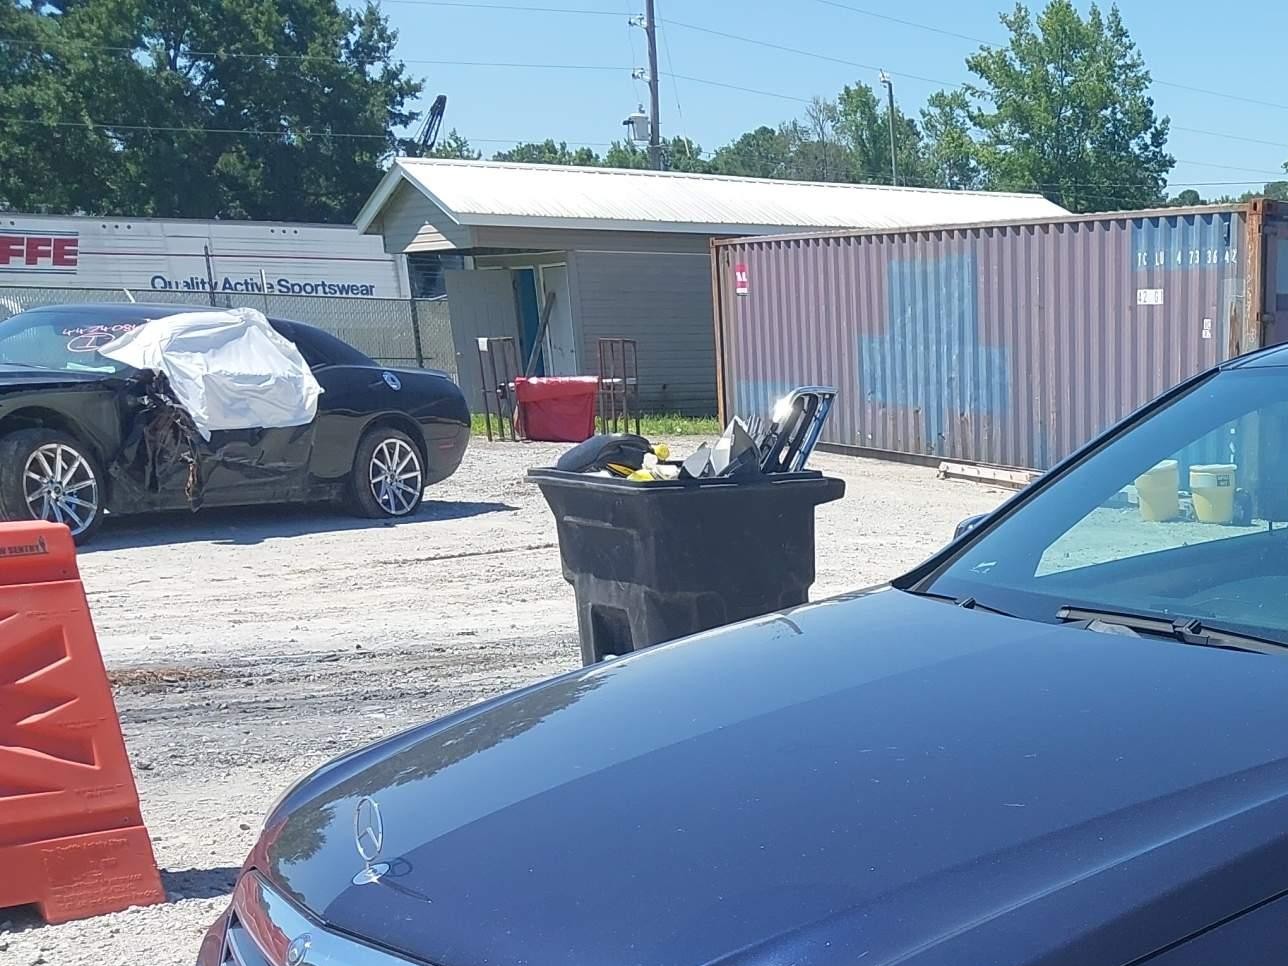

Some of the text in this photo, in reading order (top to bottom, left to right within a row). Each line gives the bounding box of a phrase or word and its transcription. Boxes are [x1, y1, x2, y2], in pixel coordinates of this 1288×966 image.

[151, 275, 375, 297] Quality Active Sportswear
